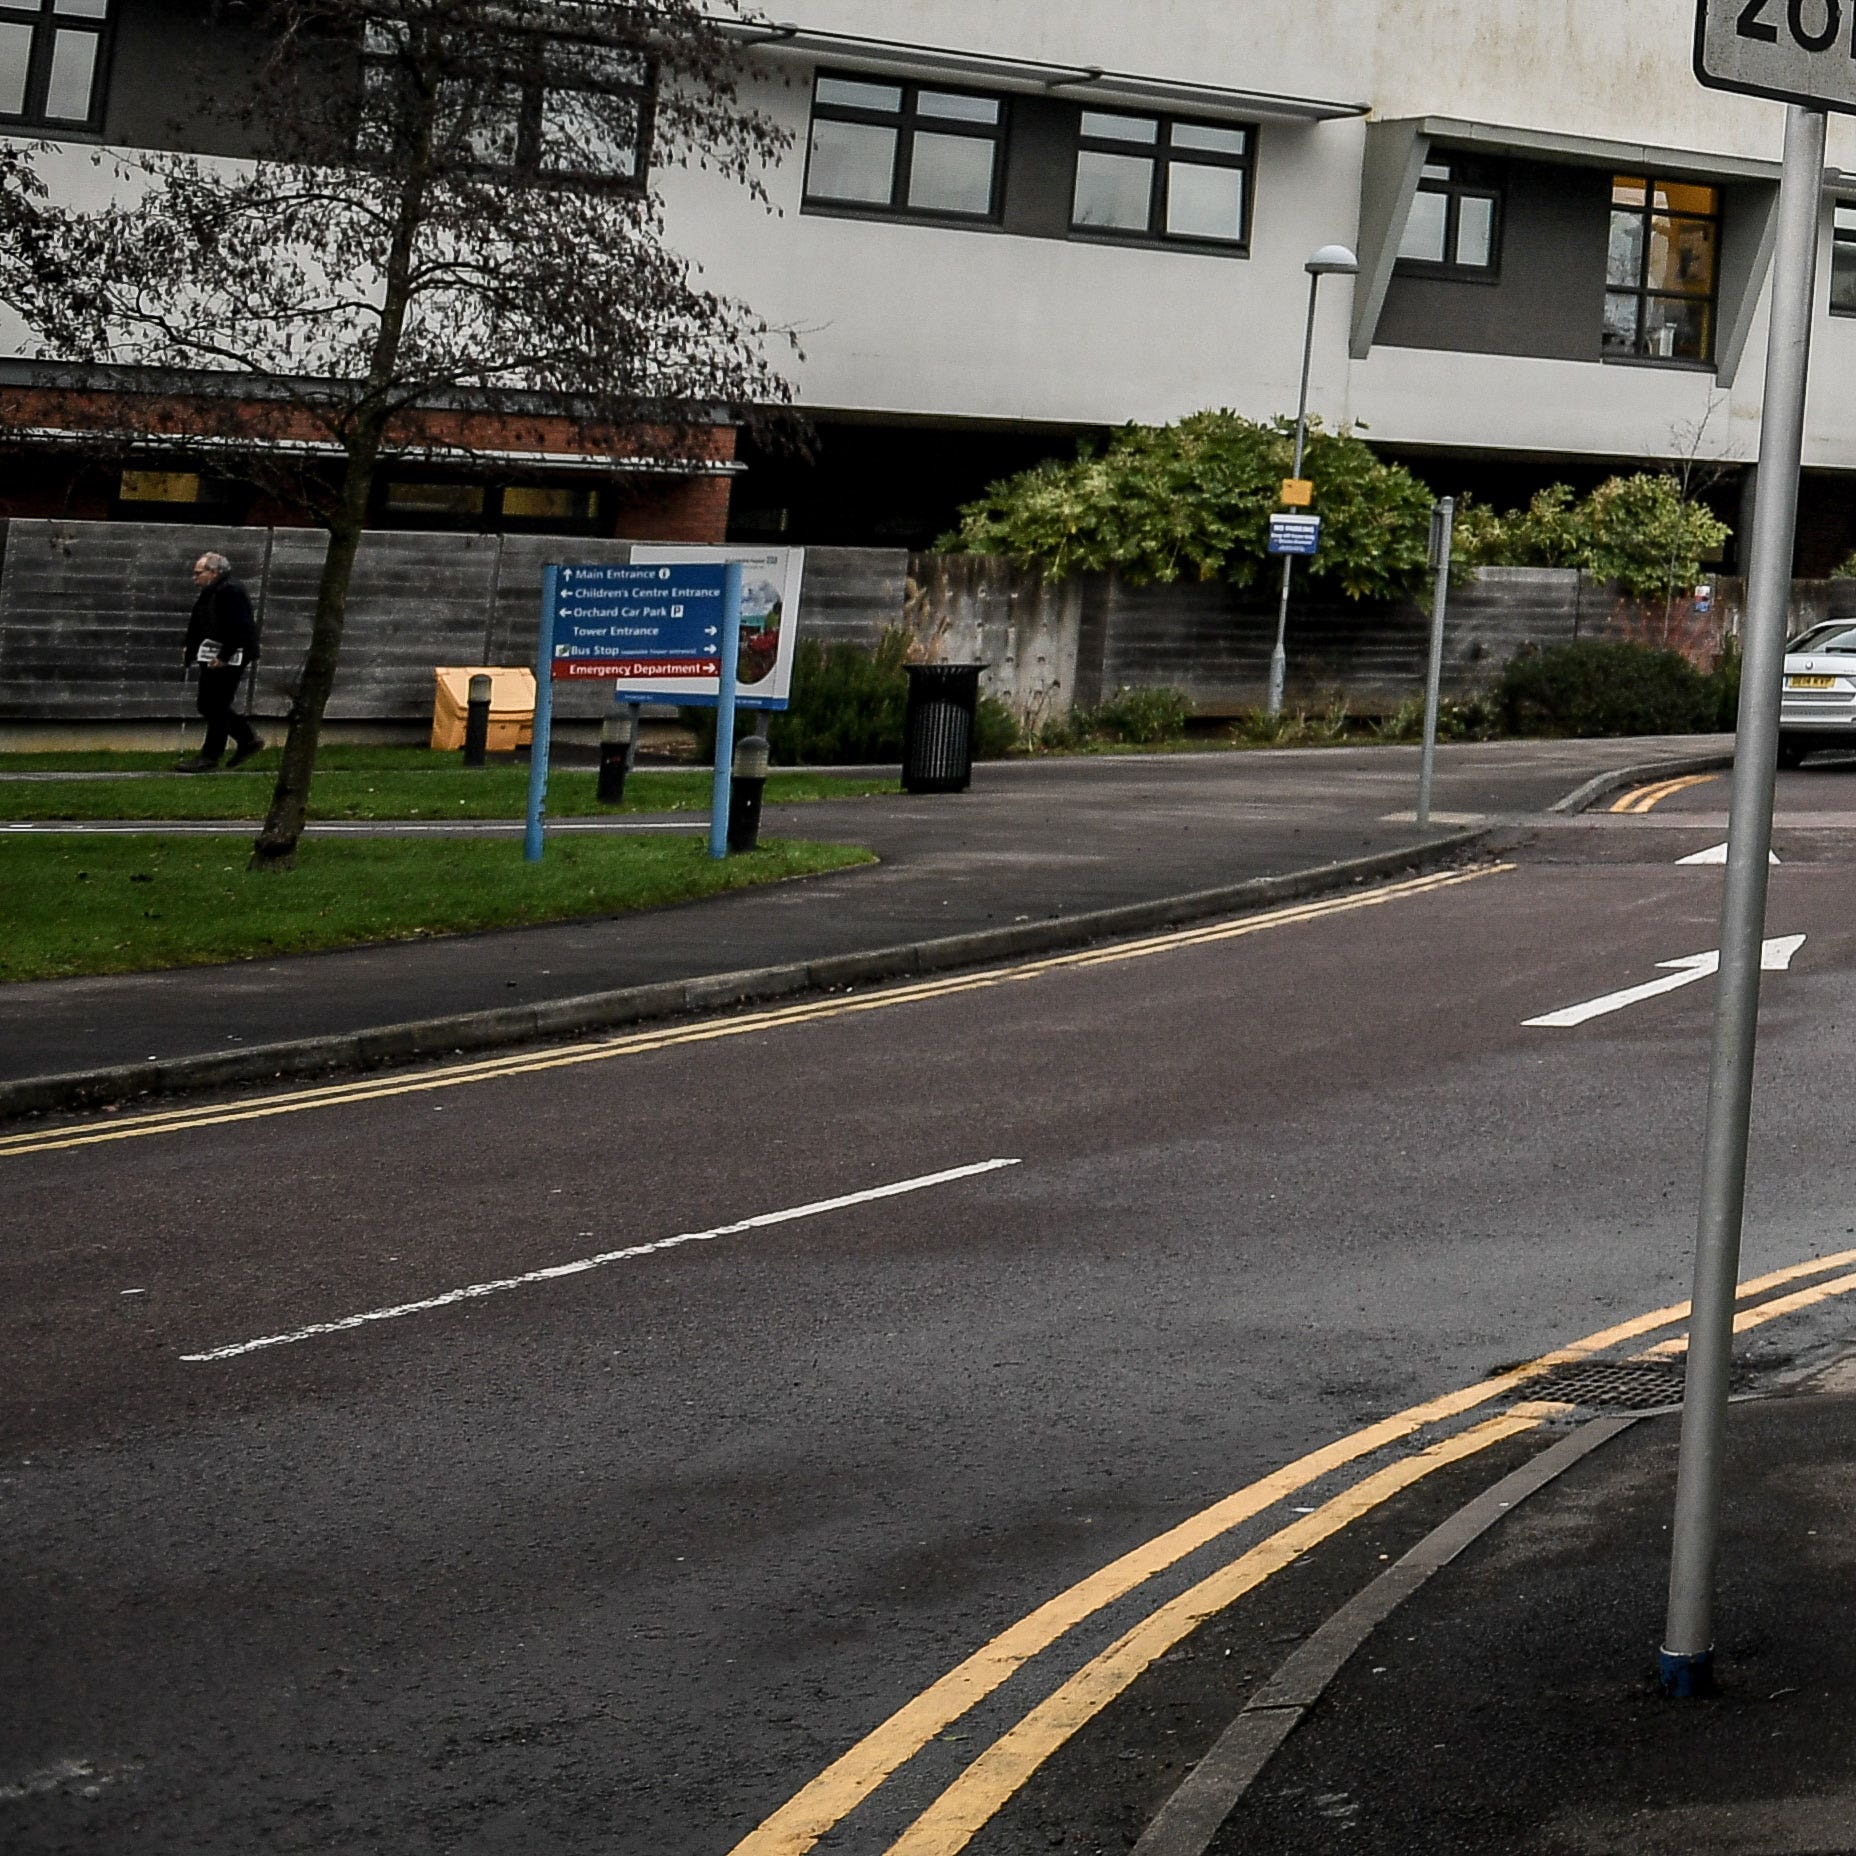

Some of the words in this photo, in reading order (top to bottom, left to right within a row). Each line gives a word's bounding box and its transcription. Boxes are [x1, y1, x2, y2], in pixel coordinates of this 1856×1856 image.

[575, 569, 603, 579] Main
[606, 569, 655, 579] Entrance
[575, 588, 629, 598] Children's
[632, 588, 668, 597] Centre
[672, 588, 721, 597] Entrance
[573, 607, 618, 617] Orchard
[621, 607, 639, 617] Car
[643, 607, 667, 617] Park
[573, 626, 607, 636] Tower
[610, 626, 659, 636] Entrance
[571, 645, 591, 655] Bus
[594, 645, 619, 656] Stop
[569, 664, 631, 676] Emergency
[634, 663, 700, 675] Department
